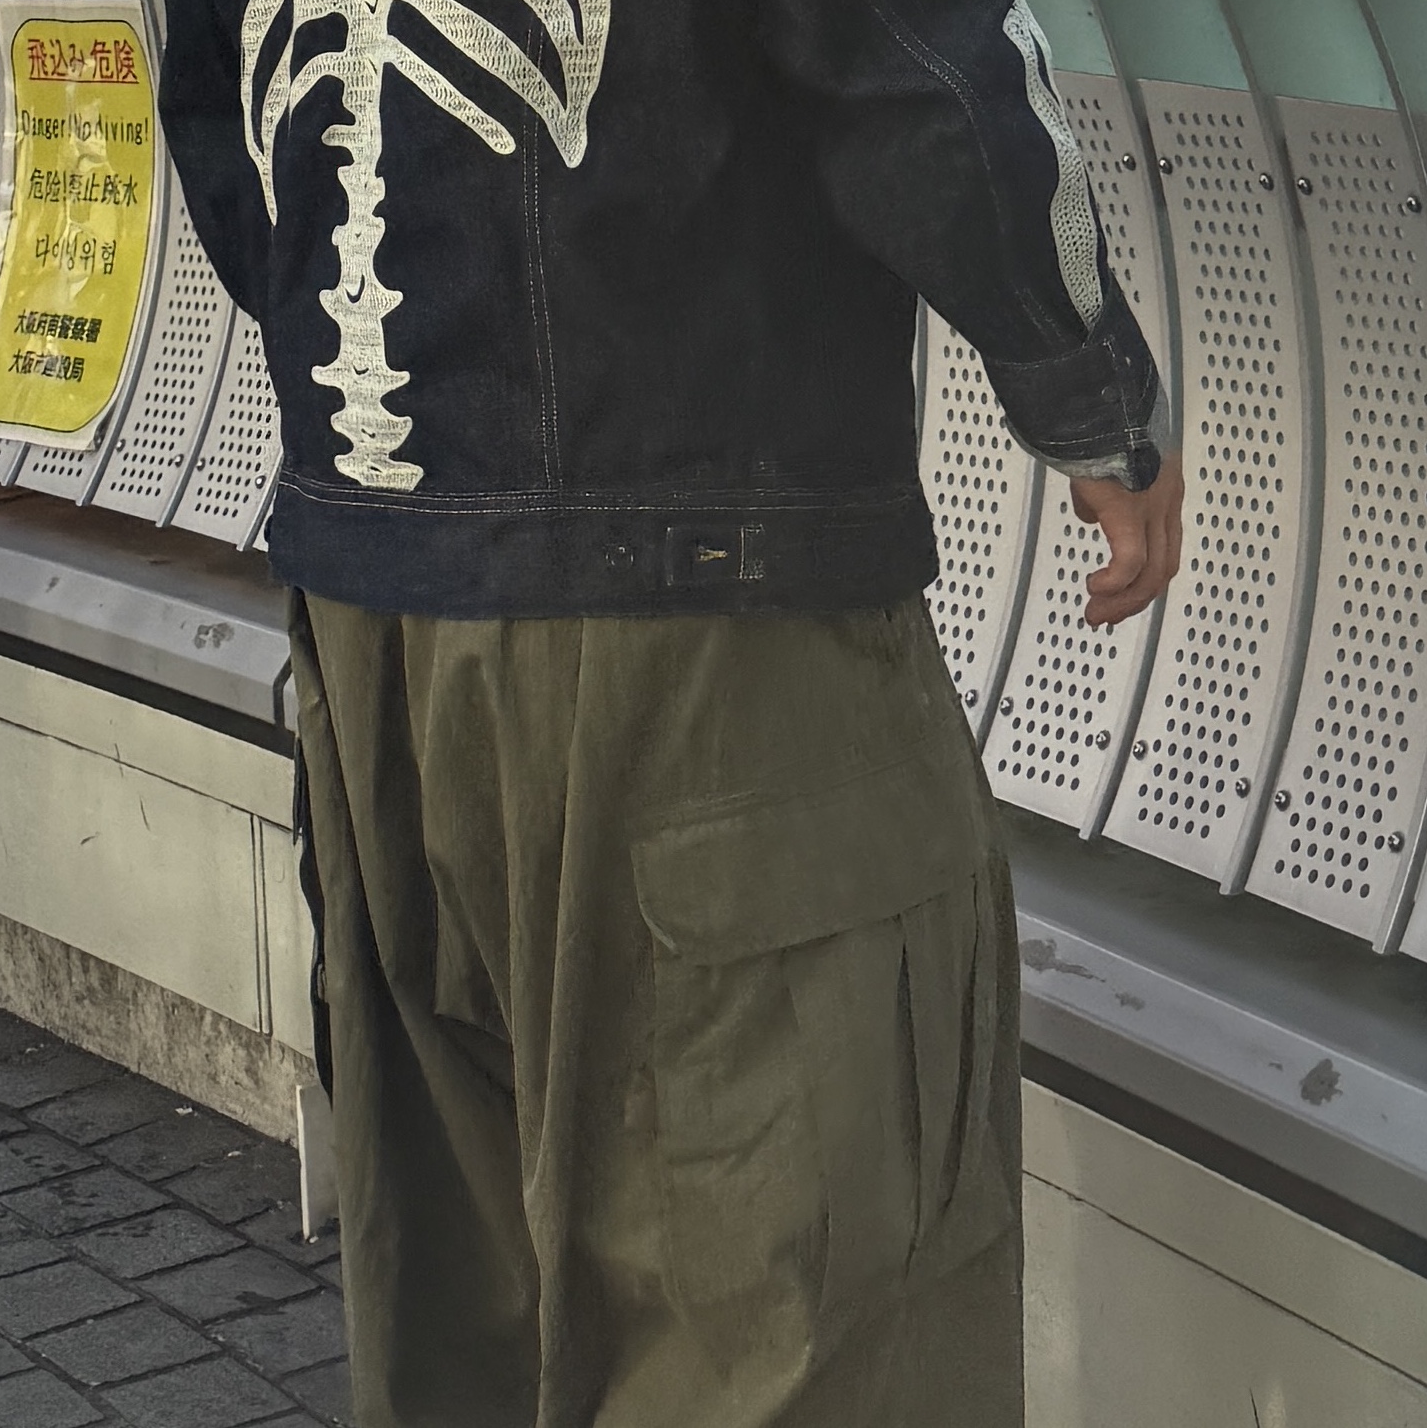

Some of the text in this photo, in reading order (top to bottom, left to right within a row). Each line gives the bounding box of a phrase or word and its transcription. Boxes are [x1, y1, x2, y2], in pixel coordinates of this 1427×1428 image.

[27, 38, 137, 80] 飛込み危険
